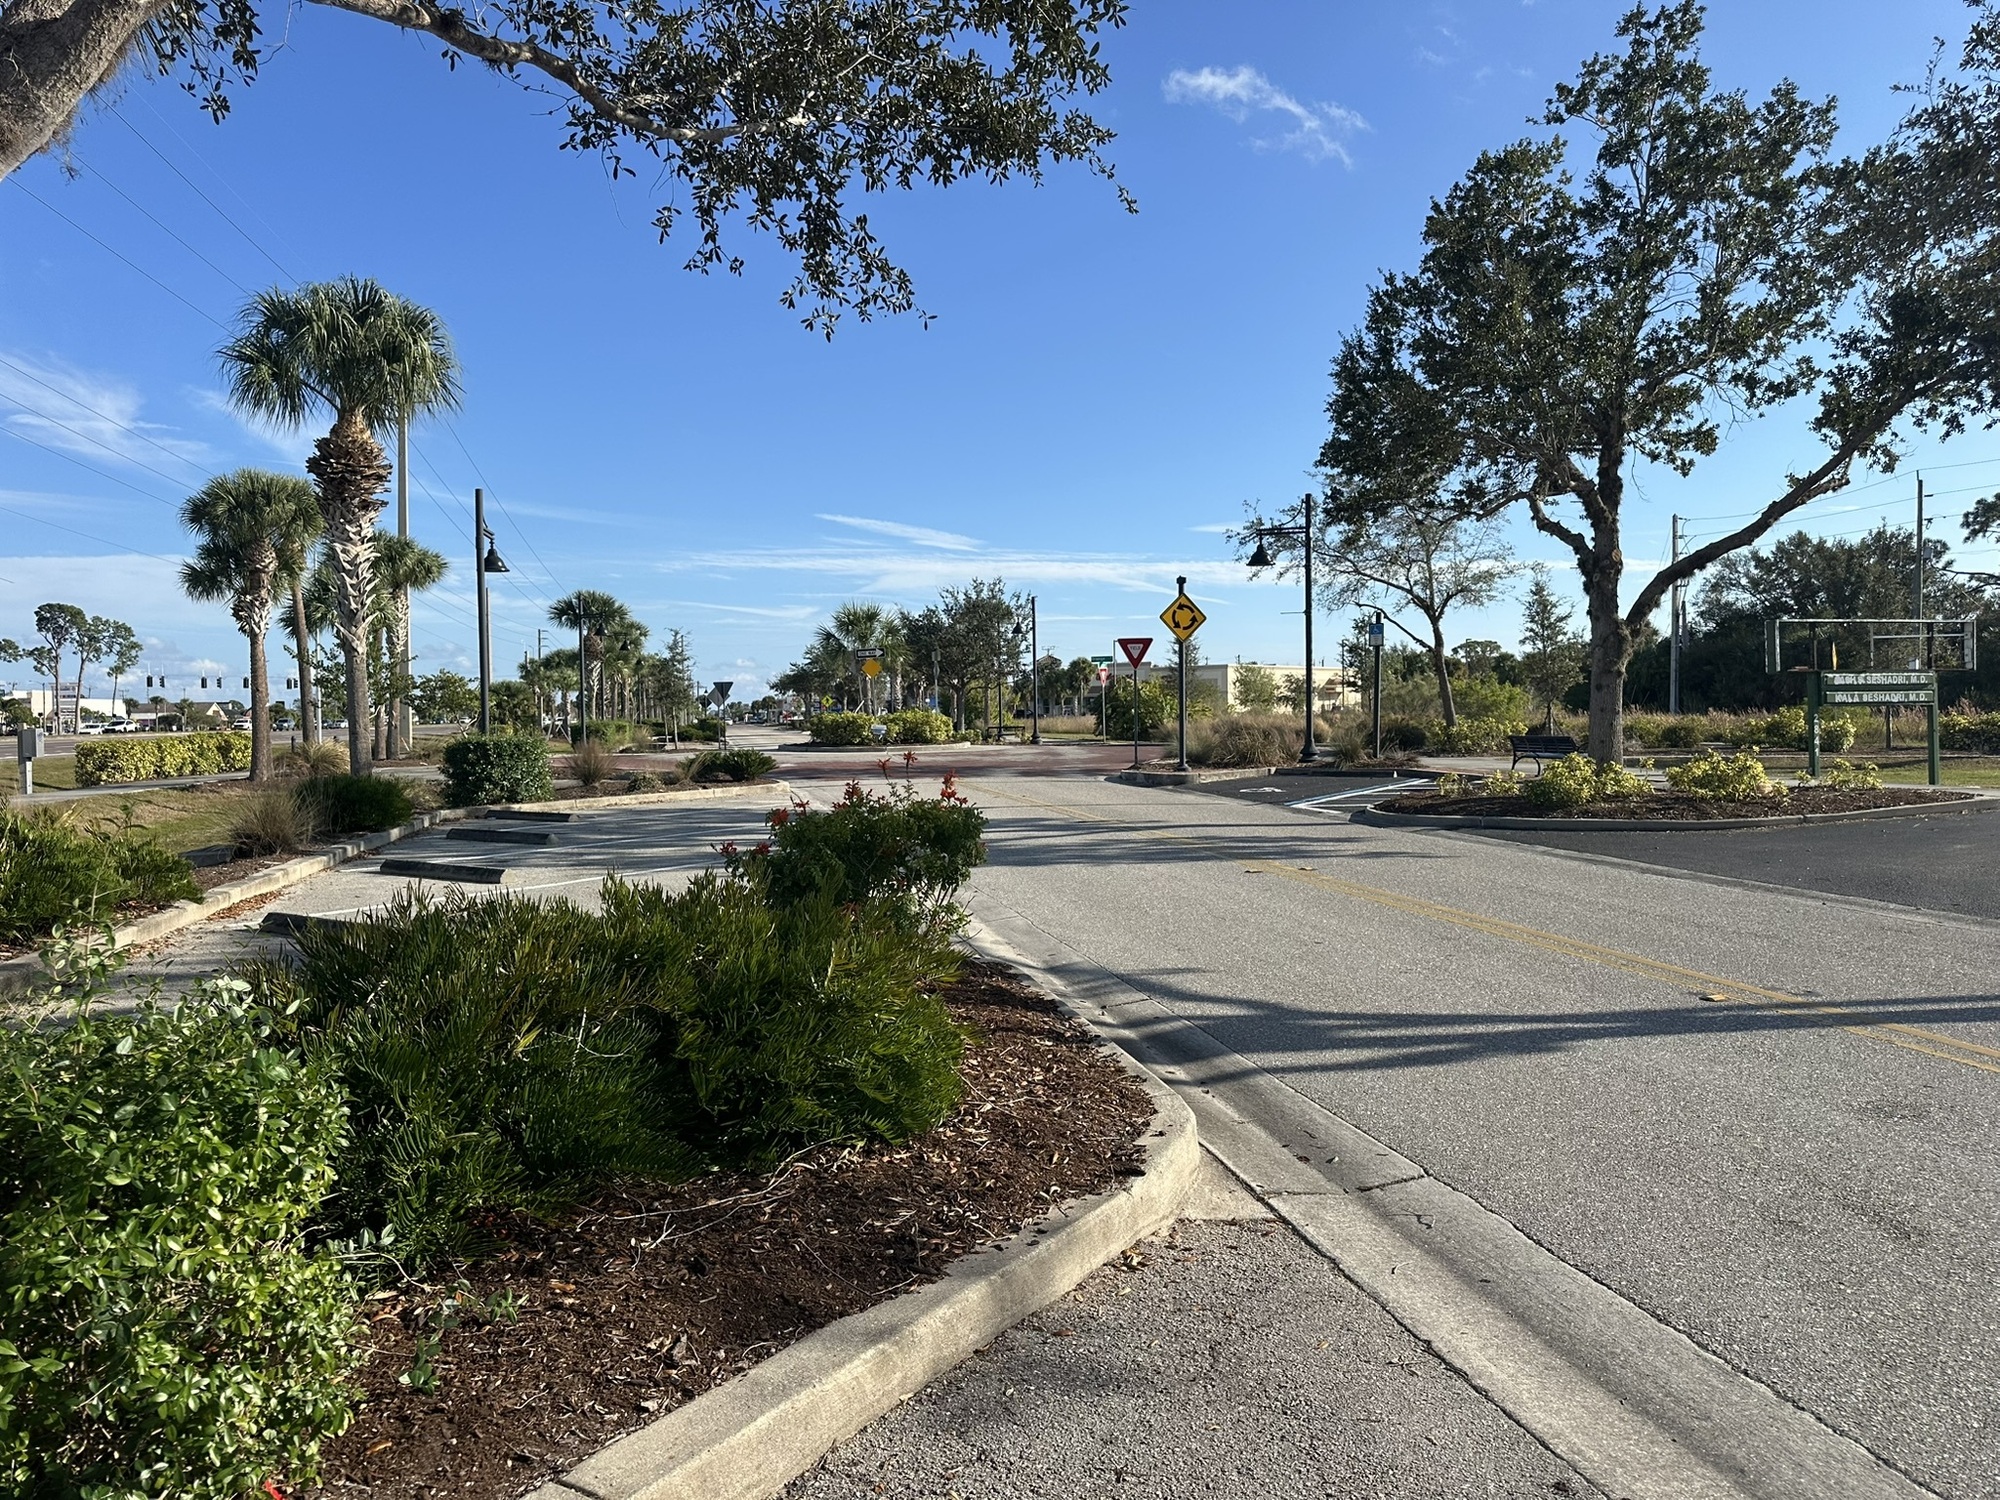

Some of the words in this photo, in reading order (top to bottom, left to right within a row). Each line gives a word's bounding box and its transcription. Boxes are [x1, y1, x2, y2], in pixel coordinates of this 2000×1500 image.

[1866, 675, 1909, 685] SESHADRI,
[1910, 675, 1928, 684] M.D.
[1862, 693, 1908, 703] SESHADRI,
[1909, 693, 1928, 701] M.D.
